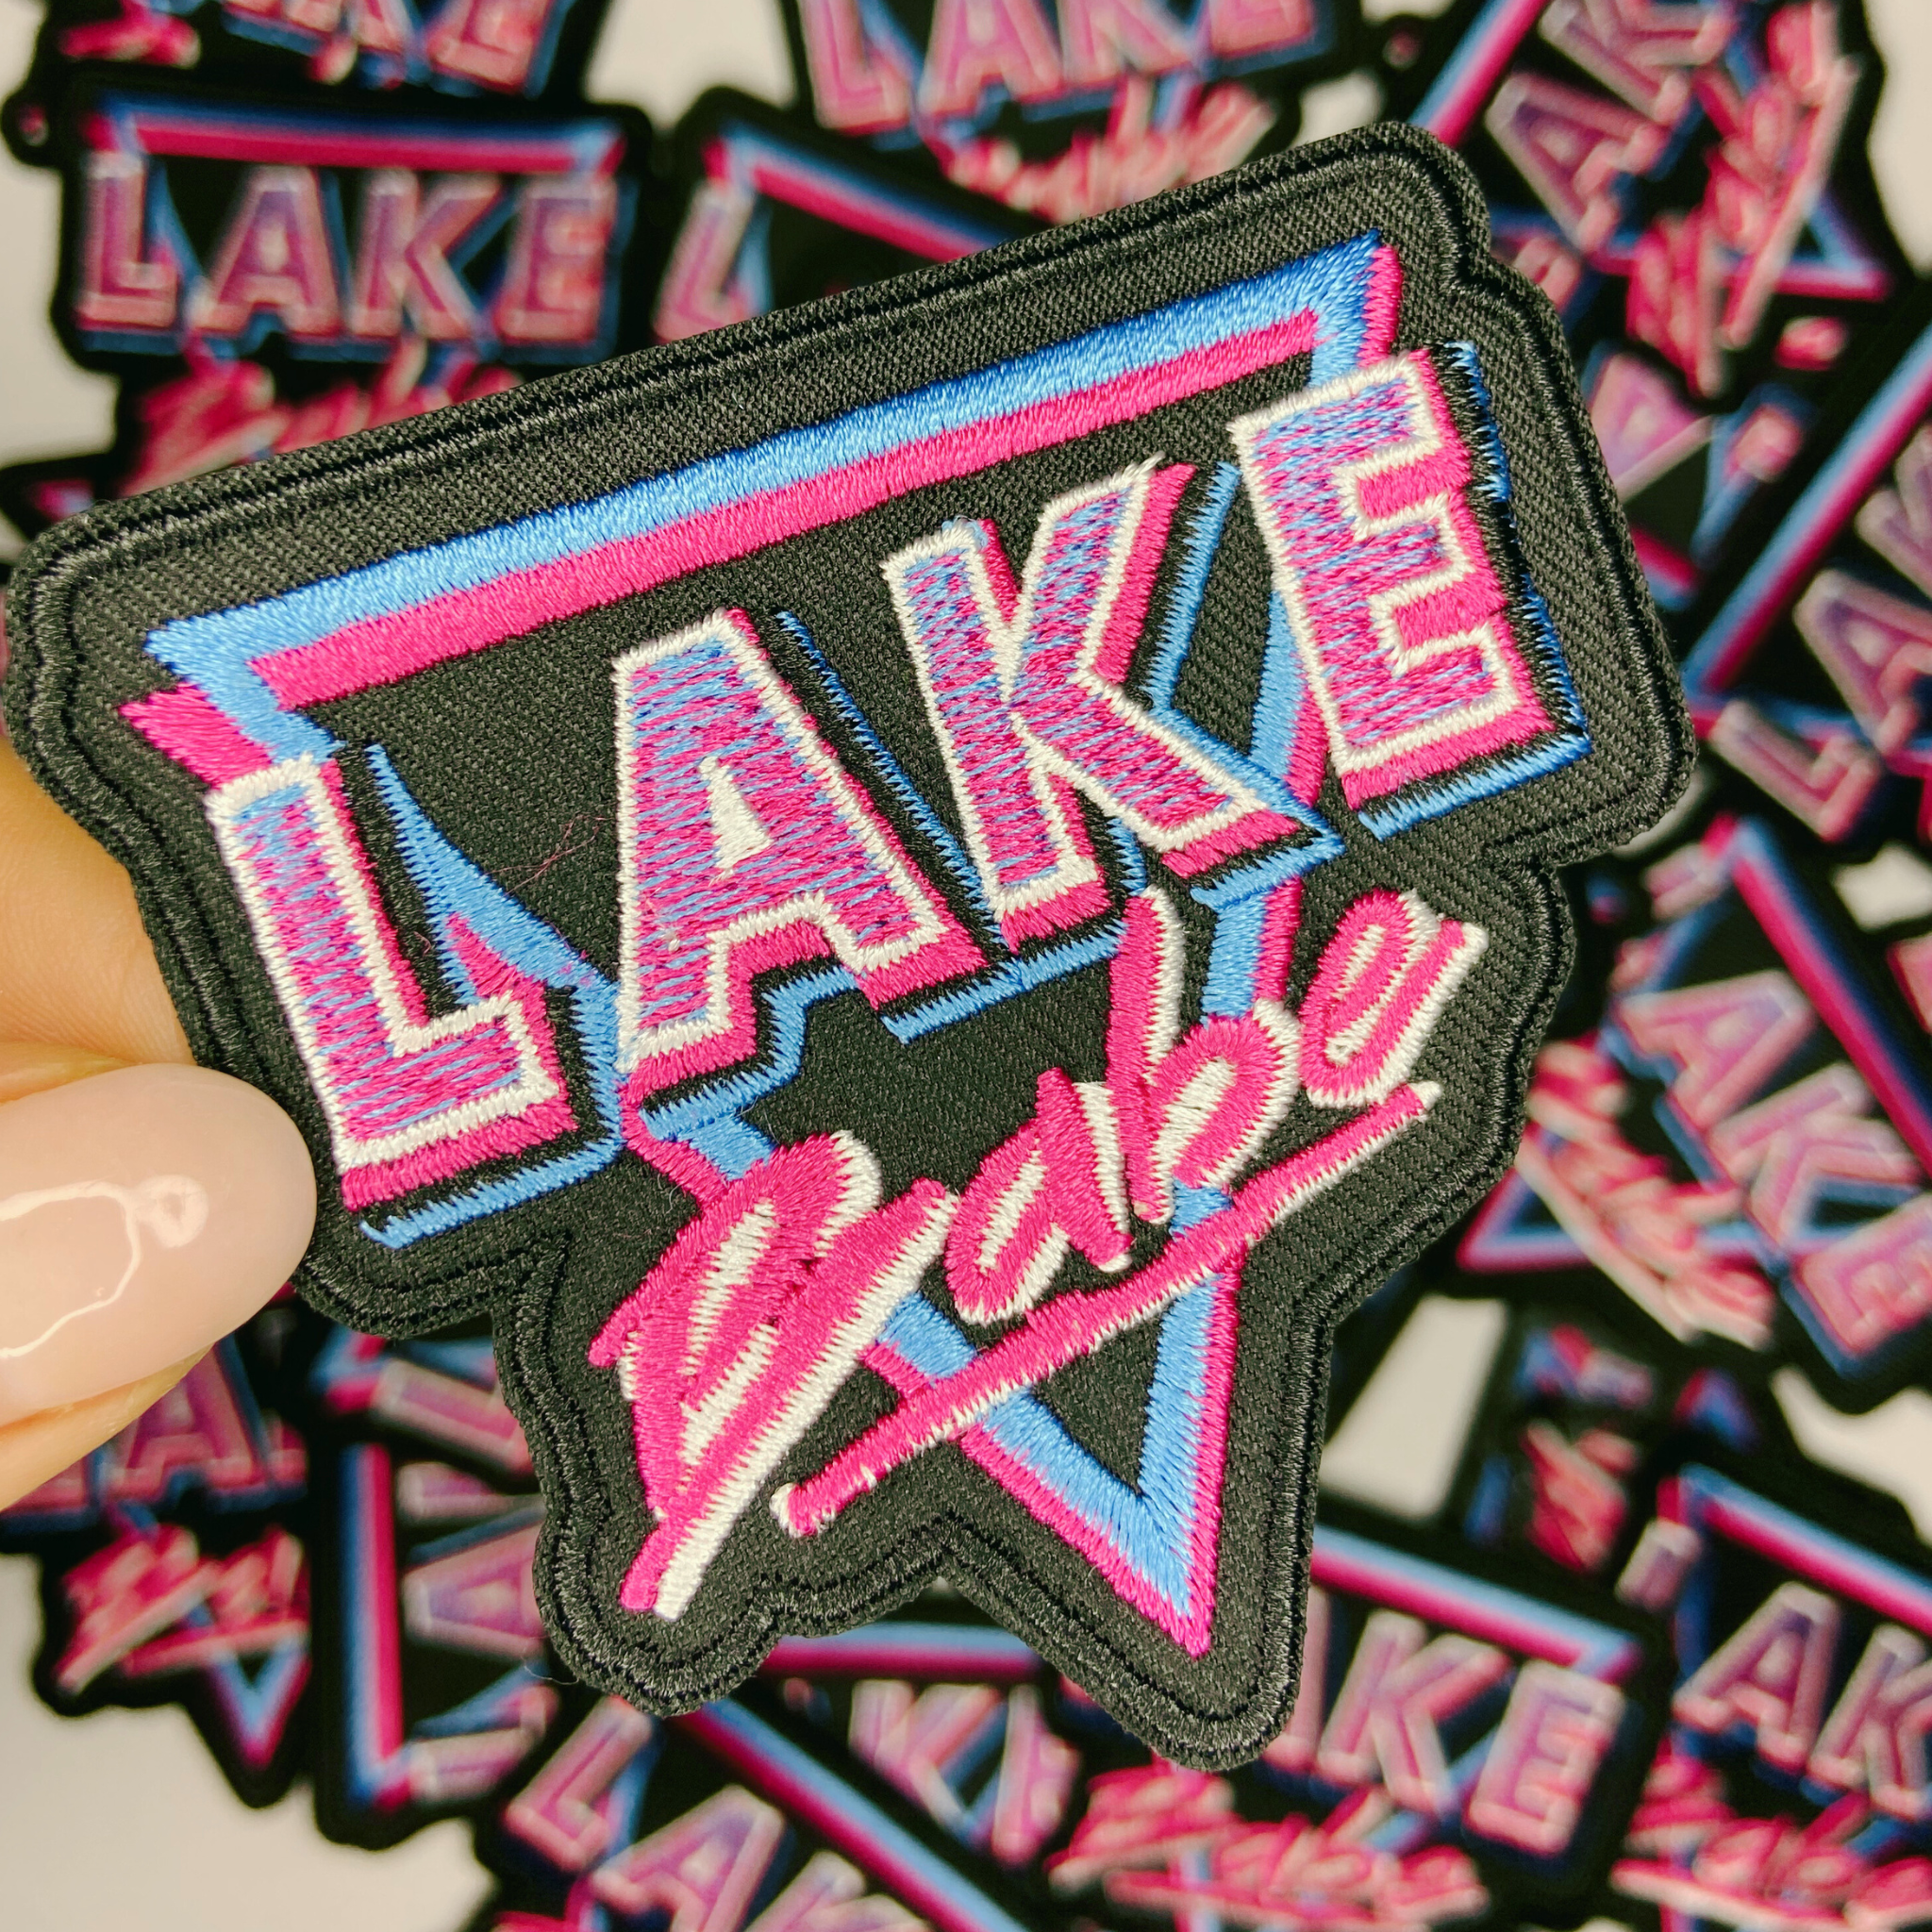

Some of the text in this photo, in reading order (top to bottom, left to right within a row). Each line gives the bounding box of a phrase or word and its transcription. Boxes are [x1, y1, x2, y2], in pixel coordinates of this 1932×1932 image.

[75, 151, 621, 347] LAKE
[202, 347, 1566, 1217] LAKE
[589, 891, 1489, 1623] Babe
